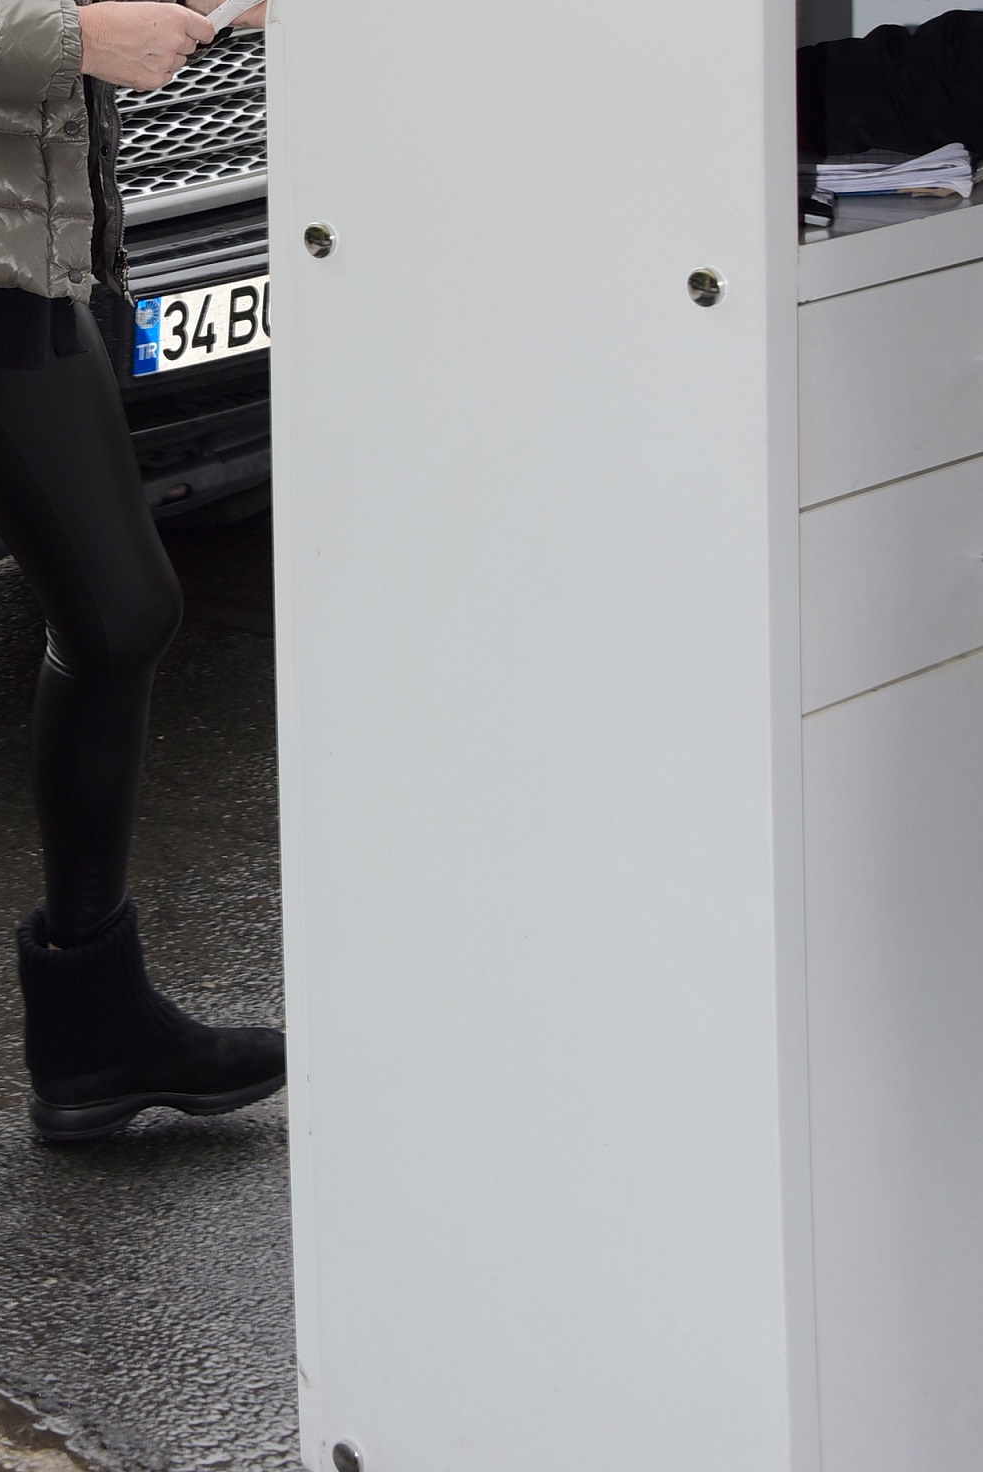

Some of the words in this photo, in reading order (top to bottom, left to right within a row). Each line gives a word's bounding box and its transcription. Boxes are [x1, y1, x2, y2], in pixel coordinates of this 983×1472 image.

[136, 342, 158, 361] TR
[163, 294, 218, 361] 34
[228, 281, 271, 349] B
